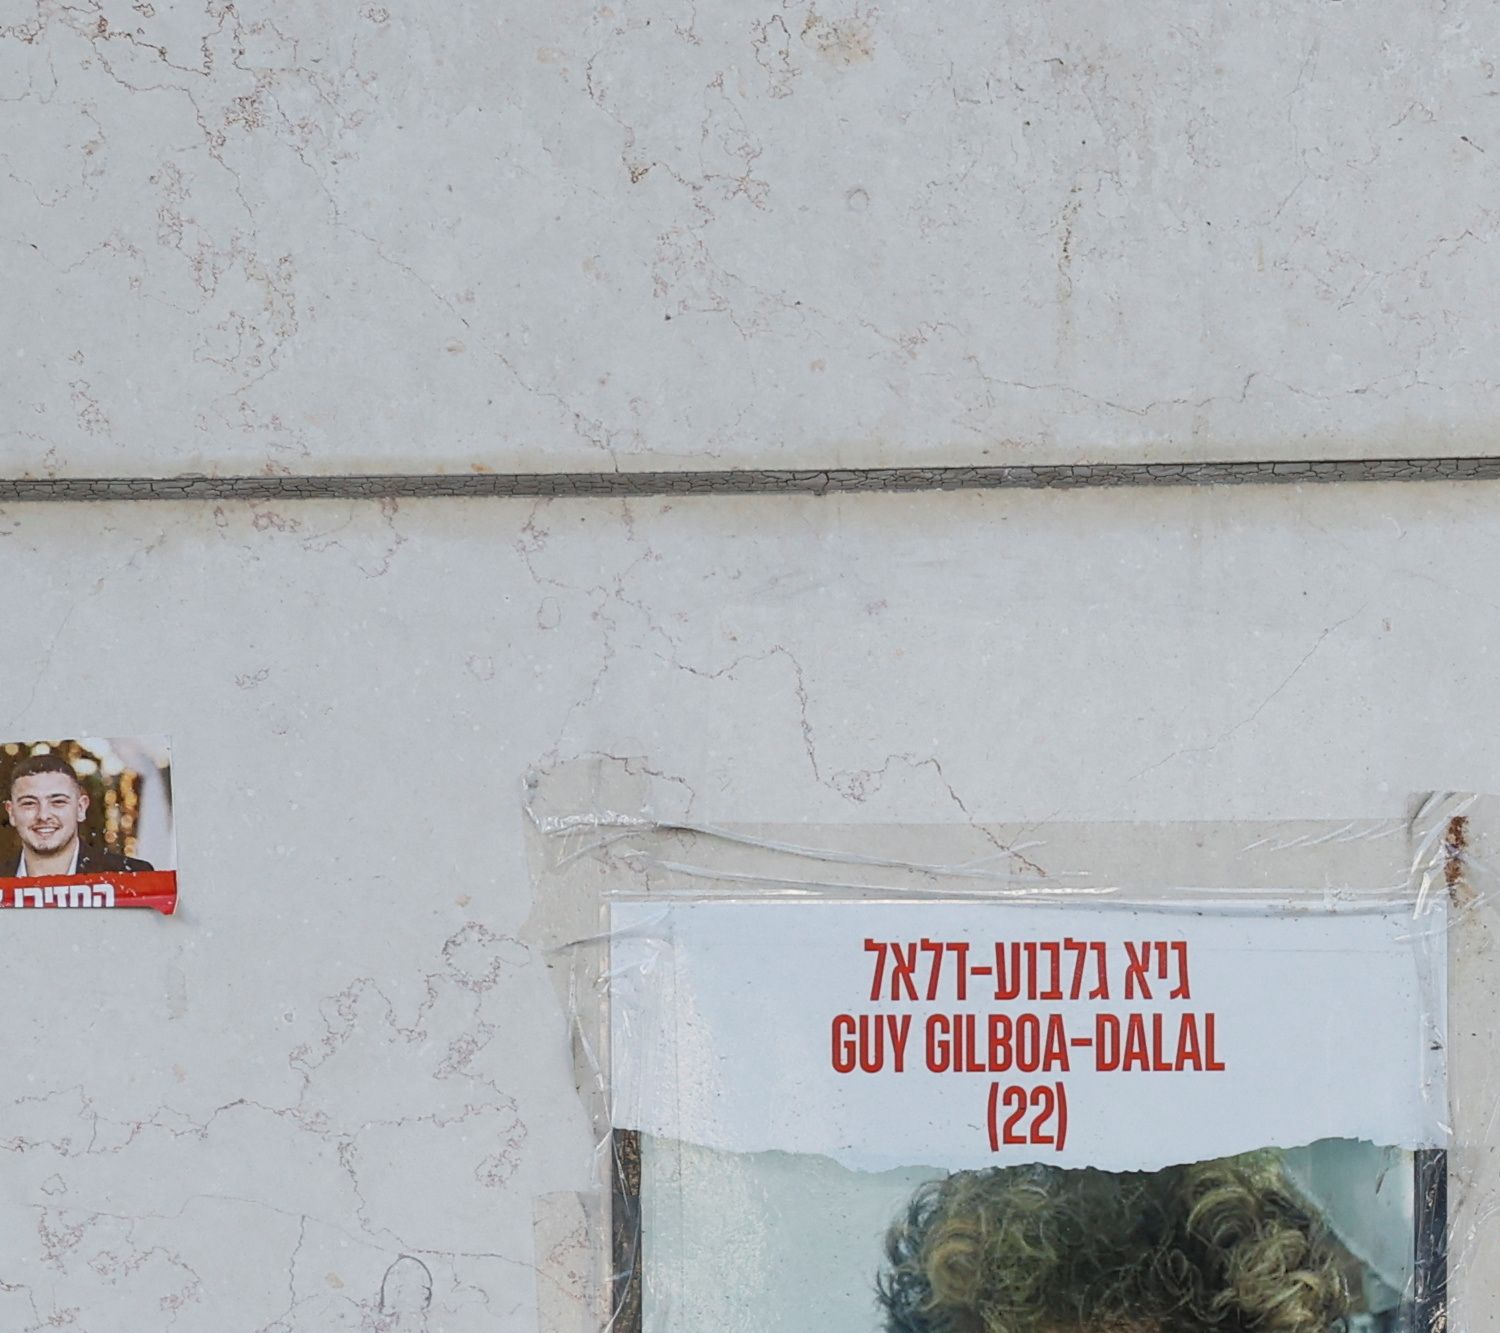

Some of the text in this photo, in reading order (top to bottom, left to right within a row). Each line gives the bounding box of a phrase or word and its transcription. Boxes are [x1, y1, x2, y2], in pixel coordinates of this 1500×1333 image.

[14, 883, 115, 908] החזירו
[864, 938, 1190, 1001] גיא גלבוע-דלאל
[832, 1013, 1225, 1073] GUY GILBOA-DALAL
[988, 1082, 1068, 1152] (22)
